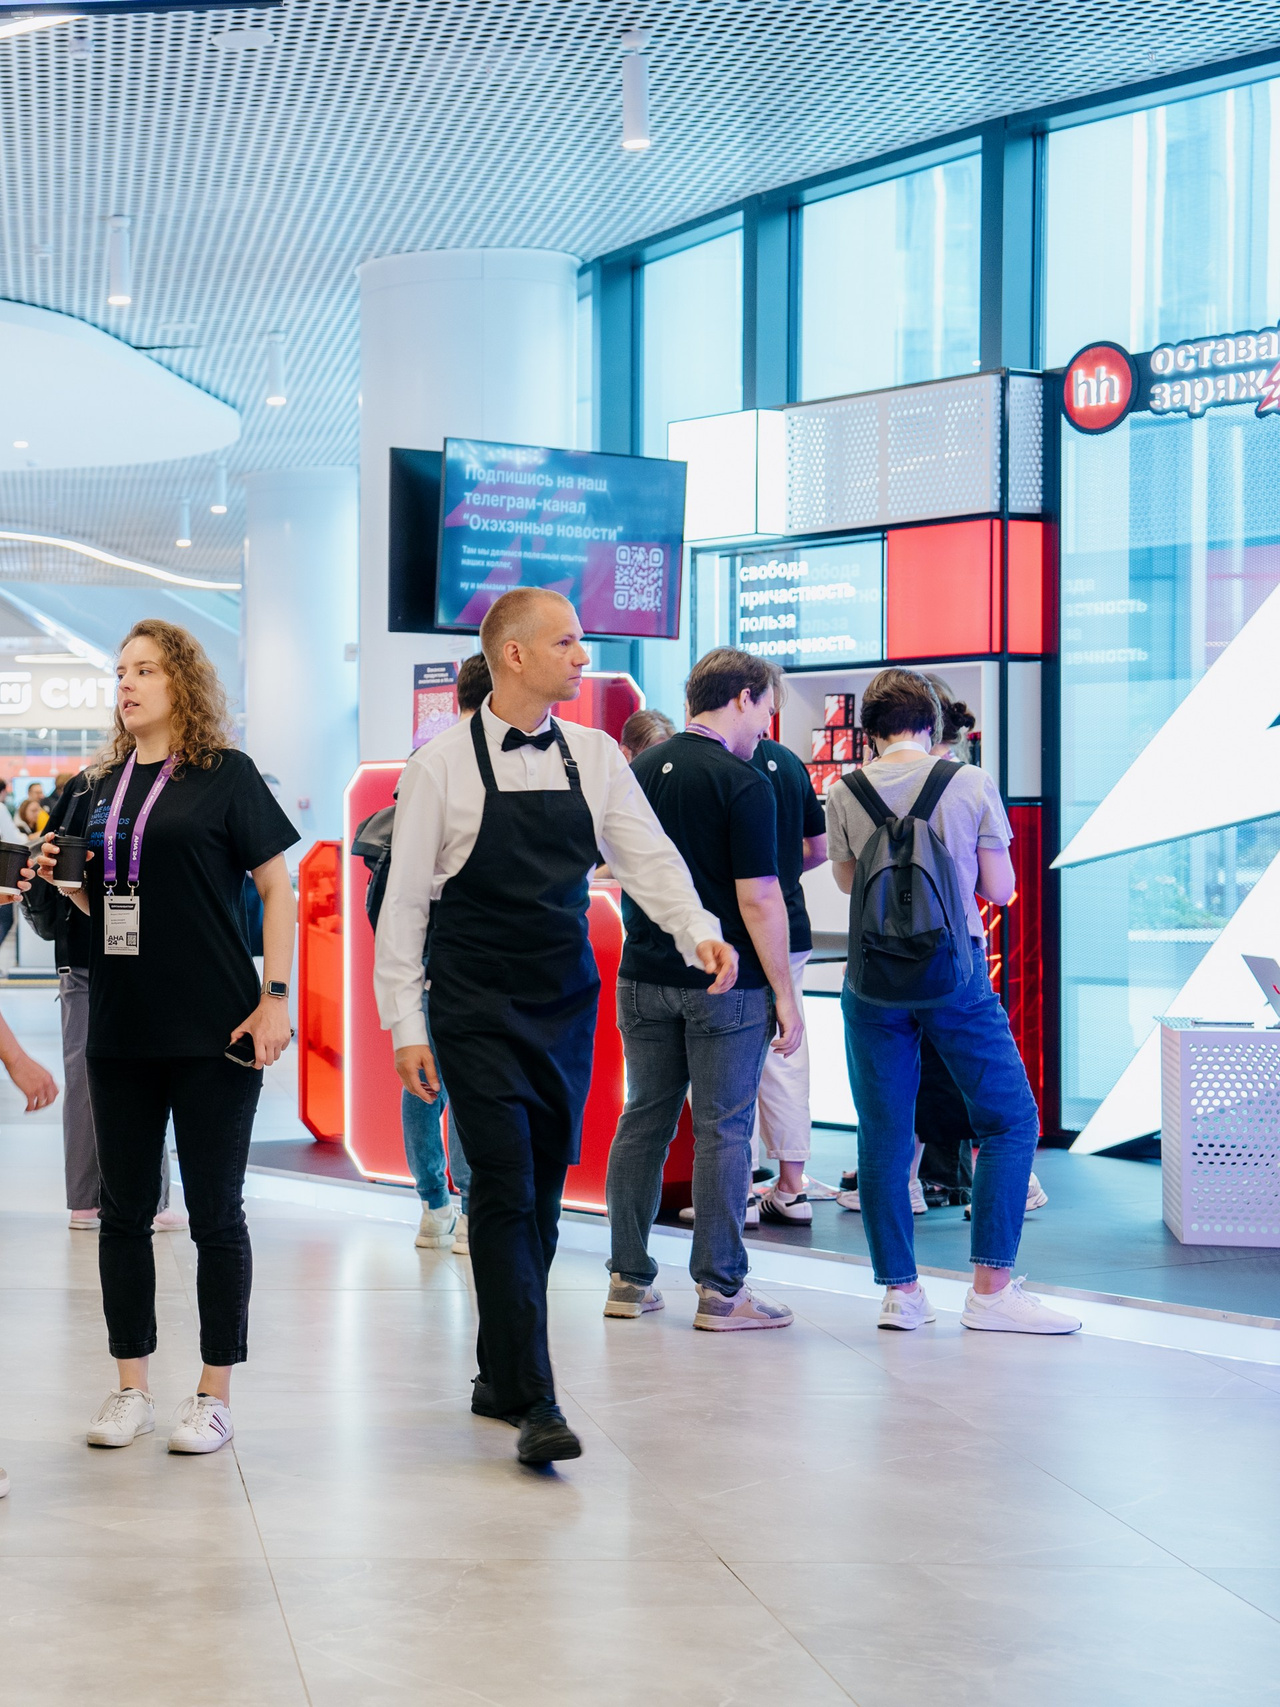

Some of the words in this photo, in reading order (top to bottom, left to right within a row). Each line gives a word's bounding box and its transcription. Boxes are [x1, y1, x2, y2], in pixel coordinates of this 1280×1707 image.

[1150, 332, 1280, 374] остава
[1073, 366, 1120, 408] hh
[1149, 369, 1268, 413] заряж
[465, 464, 554, 488] Подпишись
[557, 475, 574, 489] на
[578, 476, 607, 492] наш
[464, 490, 587, 515] телеграм-канал
[740, 559, 808, 582] свобода
[740, 582, 856, 611] причастность
[740, 613, 796, 632] польза
